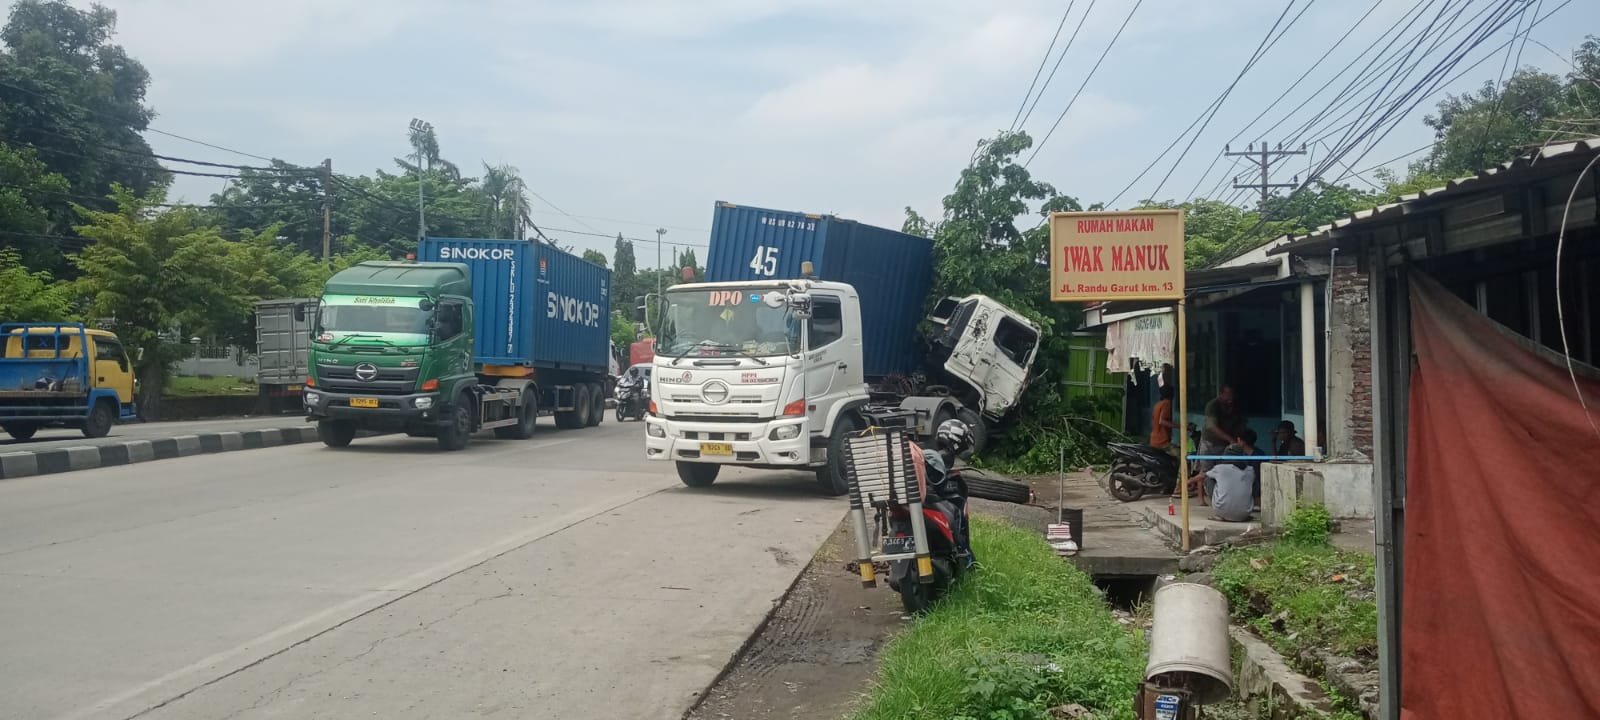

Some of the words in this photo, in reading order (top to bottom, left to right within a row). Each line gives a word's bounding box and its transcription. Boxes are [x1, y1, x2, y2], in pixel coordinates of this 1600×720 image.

[1077, 219, 1113, 234] RUMAH
[1116, 218, 1154, 232] MAKAN
[440, 246, 514, 260] SINOKOR
[749, 245, 779, 277] 45
[1063, 246, 1104, 273] IWAK
[1111, 244, 1170, 271] MANUK
[1060, 284, 1075, 293] JL.
[1077, 283, 1108, 293] Randu
[1110, 283, 1138, 292] Garut
[1142, 282, 1159, 292] km.
[1162, 281, 1174, 291] 13
[708, 290, 743, 306] DPO
[546, 291, 599, 328] SINOKOR
